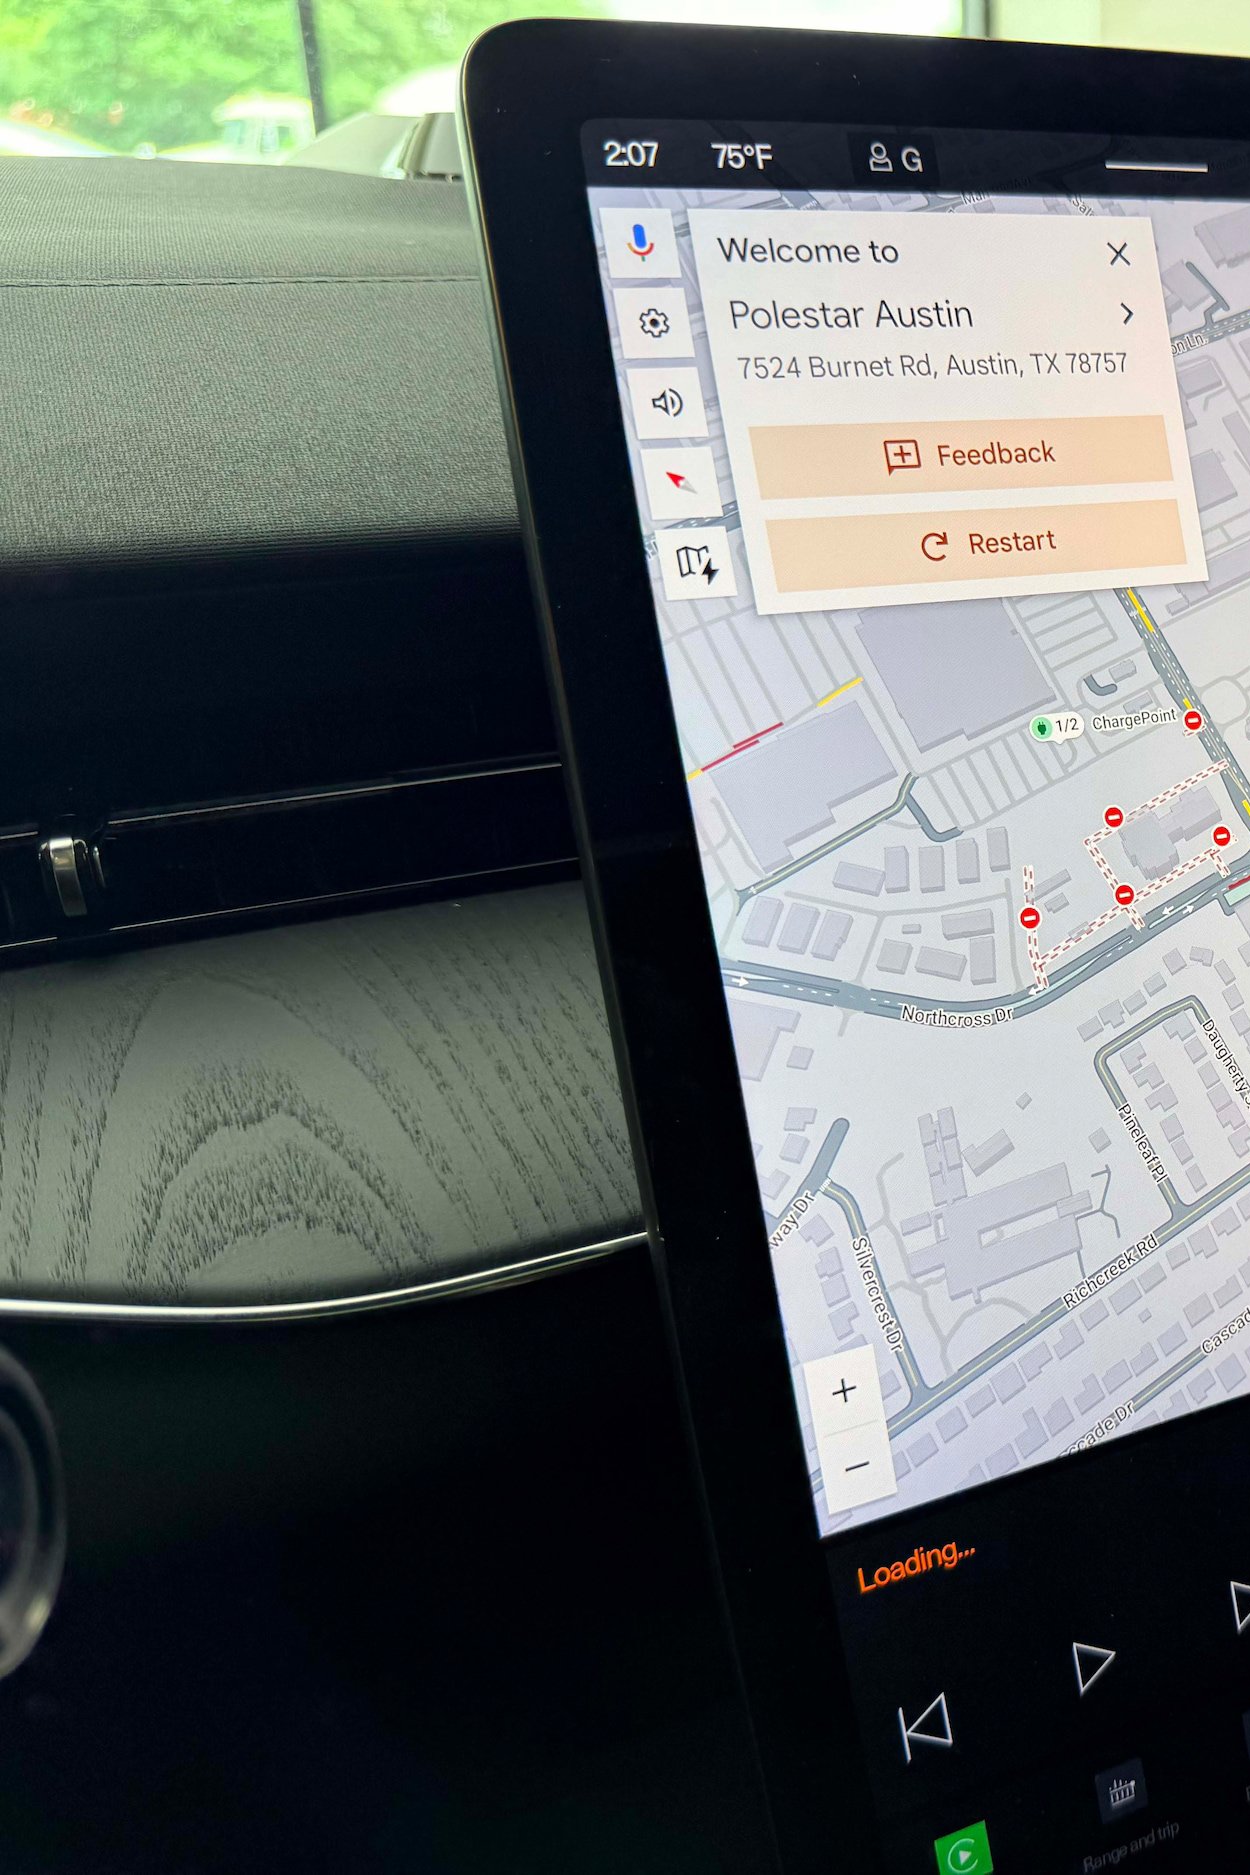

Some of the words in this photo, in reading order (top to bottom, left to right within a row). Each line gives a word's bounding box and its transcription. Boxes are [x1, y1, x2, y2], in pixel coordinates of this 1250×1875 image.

[603, 141, 660, 168] 2:07
[711, 142, 774, 170] 75°F
[717, 236, 862, 265] Welcome
[868, 240, 899, 265] to
[730, 299, 864, 331] Polestar
[875, 299, 975, 329] Austin
[1187, 332, 1206, 349] Ln
[737, 356, 802, 380] 7524
[809, 354, 894, 378] Burnet
[901, 354, 937, 380] Rd,
[946, 352, 1025, 378] Austin,
[1030, 352, 1061, 376] TX
[1065, 351, 1128, 376] 78757
[936, 440, 1057, 468] Feedback
[968, 530, 1058, 556] Restart
[1054, 716, 1080, 734] 1/2
[1092, 708, 1178, 732] ChargePoint
[901, 1005, 992, 1028] Northcross
[995, 1006, 1014, 1024] Dr
[1118, 1104, 1160, 1166] Pineleaf
[1151, 1160, 1168, 1184] Pl
[792, 1191, 815, 1214] Dr
[1062, 1247, 1139, 1309] Richcreek
[1131, 1233, 1158, 1260] Rd
[852, 1237, 903, 1338] Silvercrest
[888, 1331, 904, 1353] Dr
[1113, 1401, 1135, 1423] Dr
[857, 1541, 977, 1594] Loading...
[1083, 1846, 1127, 1874] Range
[1129, 1832, 1156, 1856] and
[1155, 1819, 1181, 1852] trip
